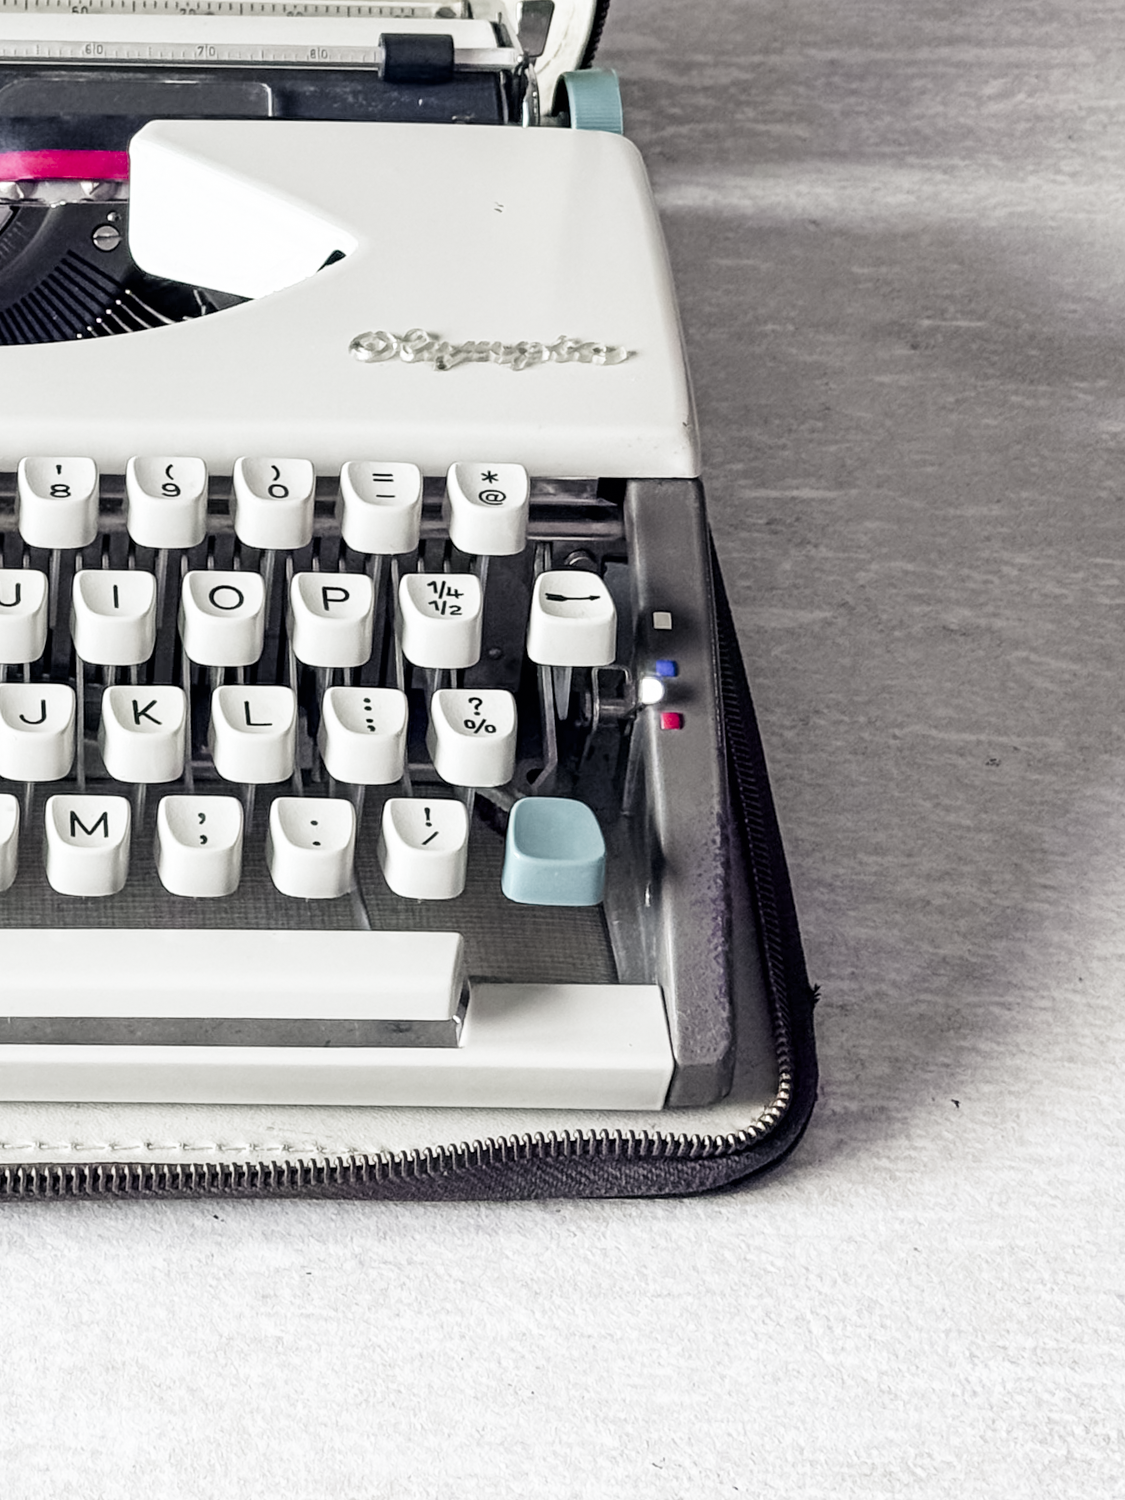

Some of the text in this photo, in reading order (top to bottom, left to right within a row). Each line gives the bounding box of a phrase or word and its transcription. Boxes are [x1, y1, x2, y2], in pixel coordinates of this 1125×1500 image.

[85, 42, 103, 55] 60
[197, 44, 216, 57] 70
[310, 47, 328, 60] 80
[49, 483, 72, 499] 8
[161, 482, 181, 498] 9
[478, 489, 507, 506] @
[112, 584, 119, 609] I
[208, 584, 245, 611] O
[321, 586, 350, 612] P
[18, 699, 47, 725] J
[131, 699, 162, 726] K
[243, 700, 273, 727] L
[467, 696, 483, 716] ?
[463, 718, 497, 735] %
[69, 810, 109, 838] M
